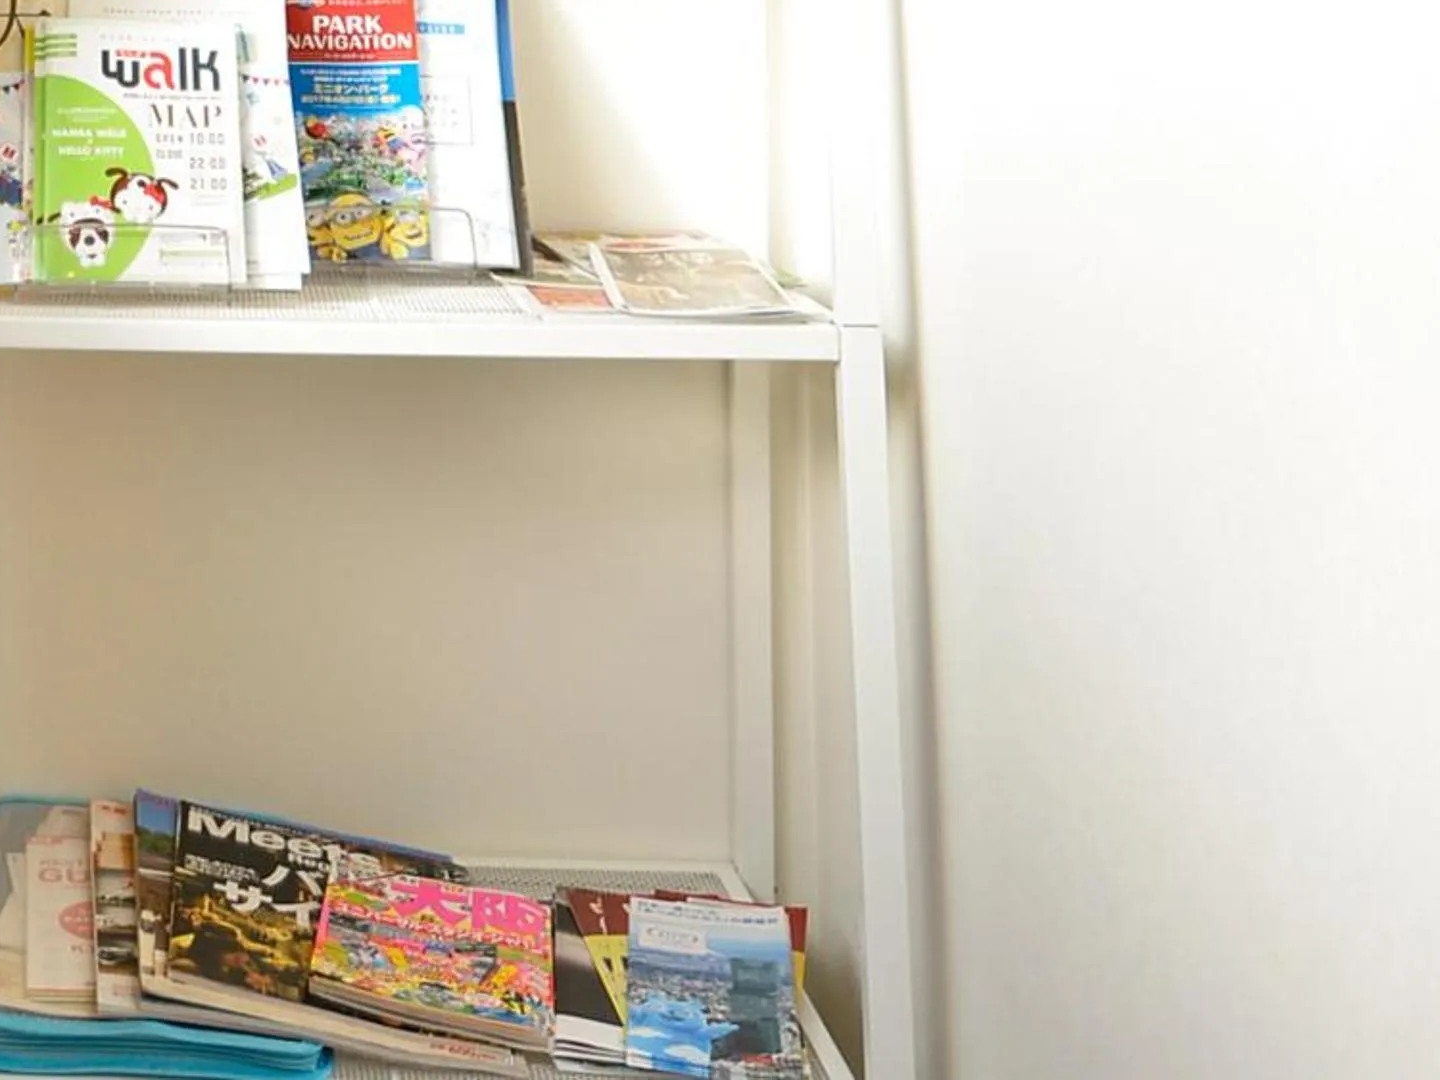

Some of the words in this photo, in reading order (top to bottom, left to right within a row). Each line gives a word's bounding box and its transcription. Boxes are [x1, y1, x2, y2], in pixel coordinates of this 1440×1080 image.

[312, 15, 383, 34] PARK
[287, 32, 413, 51] NAVIGATION
[150, 104, 222, 128] MAP
[188, 806, 380, 880] Meets
